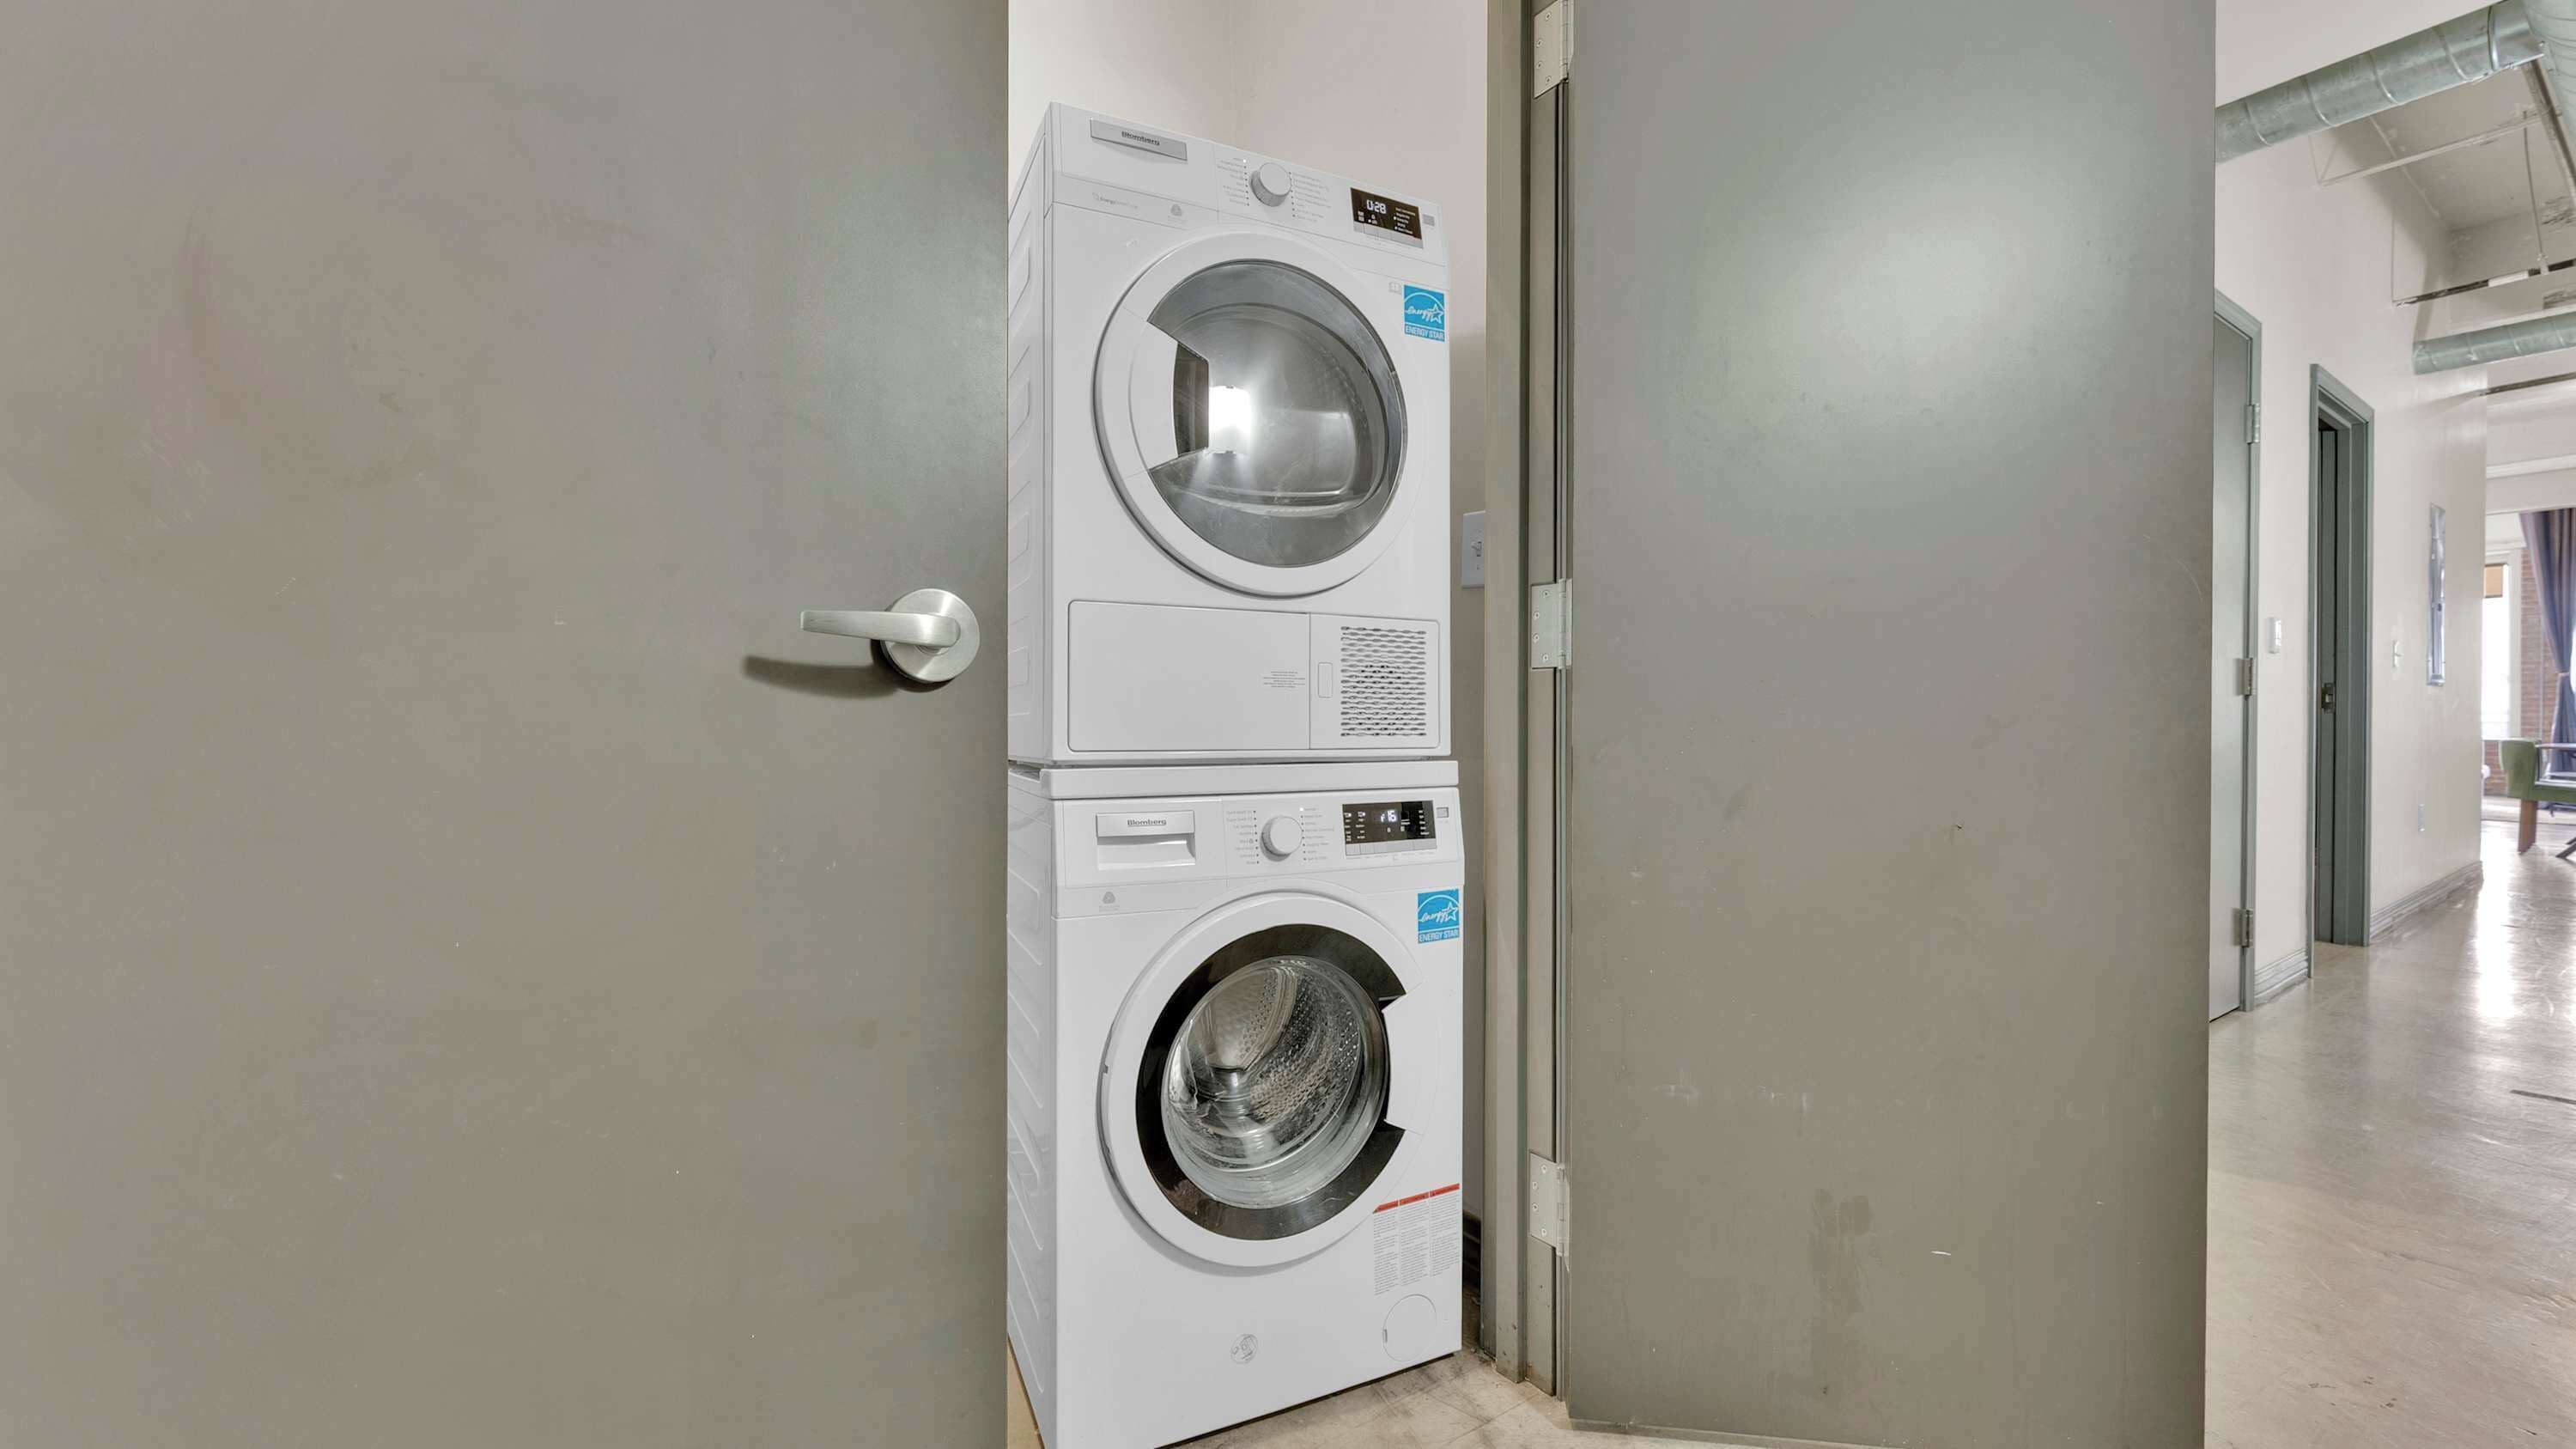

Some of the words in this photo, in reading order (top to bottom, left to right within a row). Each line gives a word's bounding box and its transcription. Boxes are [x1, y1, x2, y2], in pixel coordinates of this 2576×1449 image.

[1406, 326, 1428, 338] ENERGY
[1429, 330, 1444, 340] STAR
[1419, 932, 1443, 942] ENERGY
[1443, 929, 1459, 940] STAR
